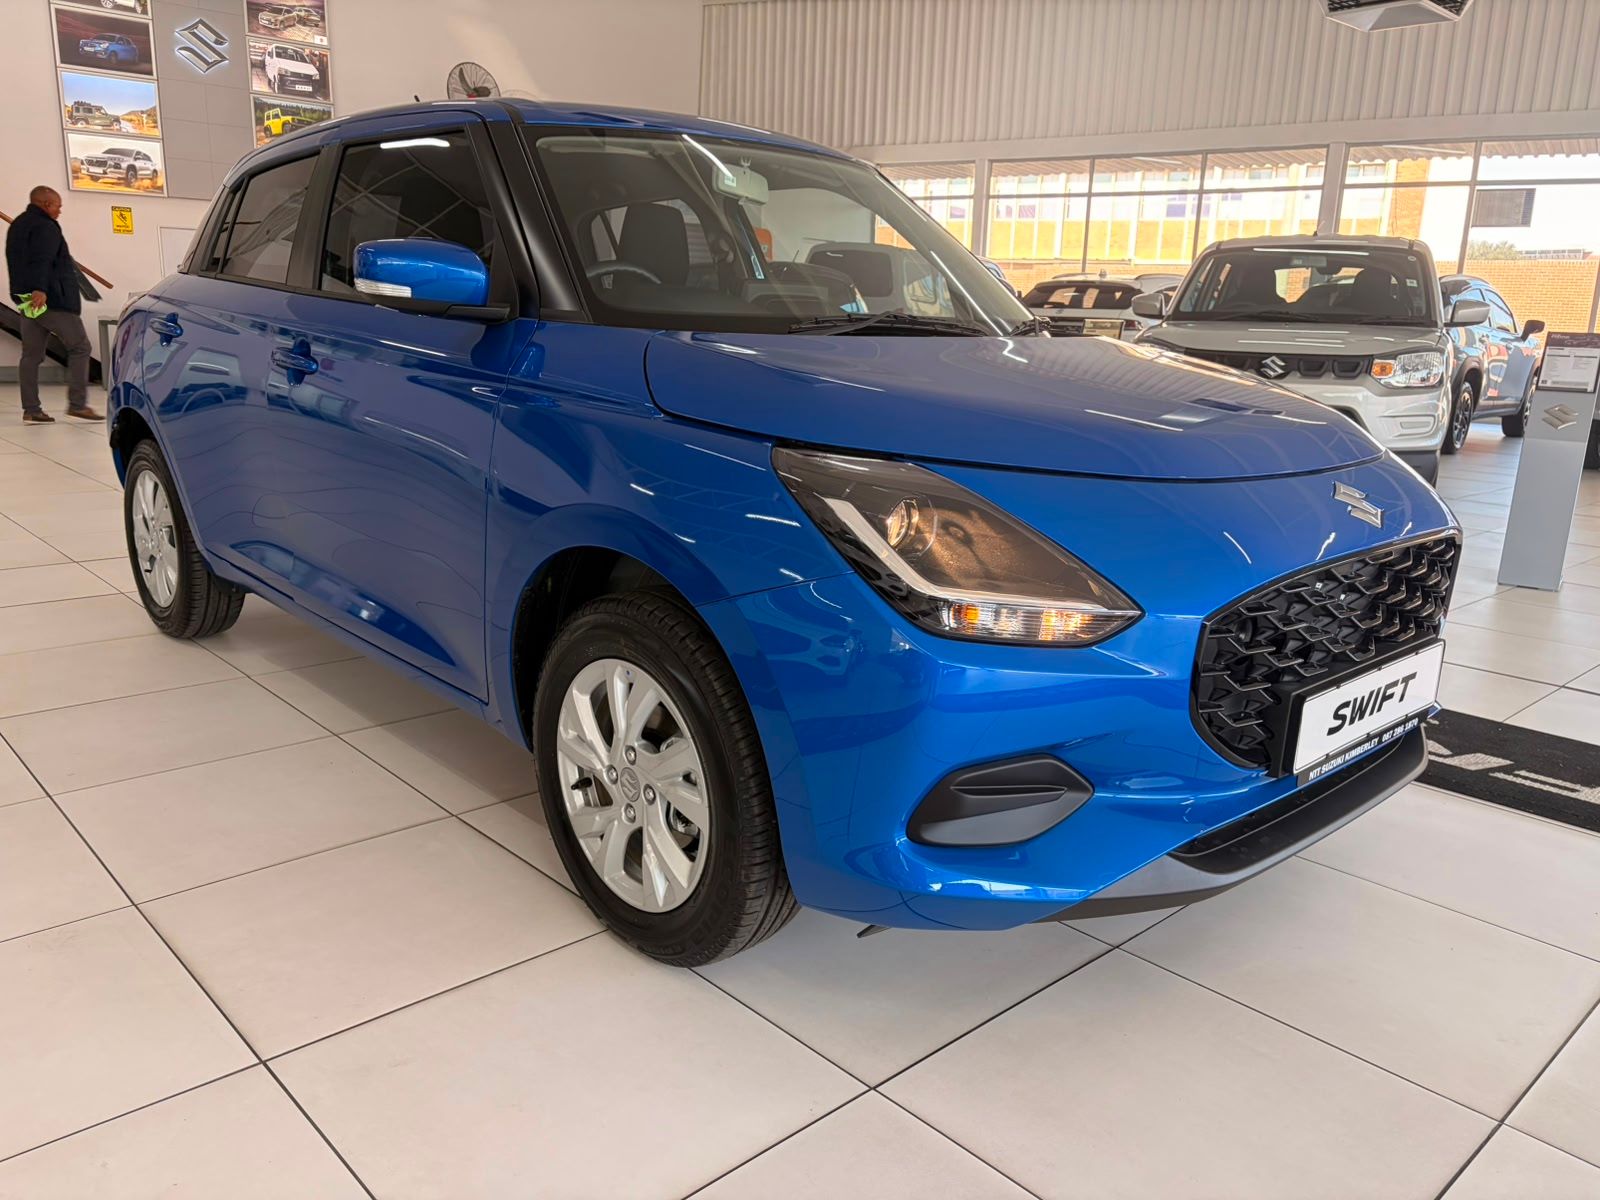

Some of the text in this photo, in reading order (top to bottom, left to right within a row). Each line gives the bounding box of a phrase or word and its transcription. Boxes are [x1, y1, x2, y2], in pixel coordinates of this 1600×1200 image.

[1326, 671, 1418, 737] SWIFT
[1309, 768, 1322, 781] NTT
[1321, 755, 1345, 773] SUZUKI
[1345, 737, 1379, 760] KIMBERLEY
